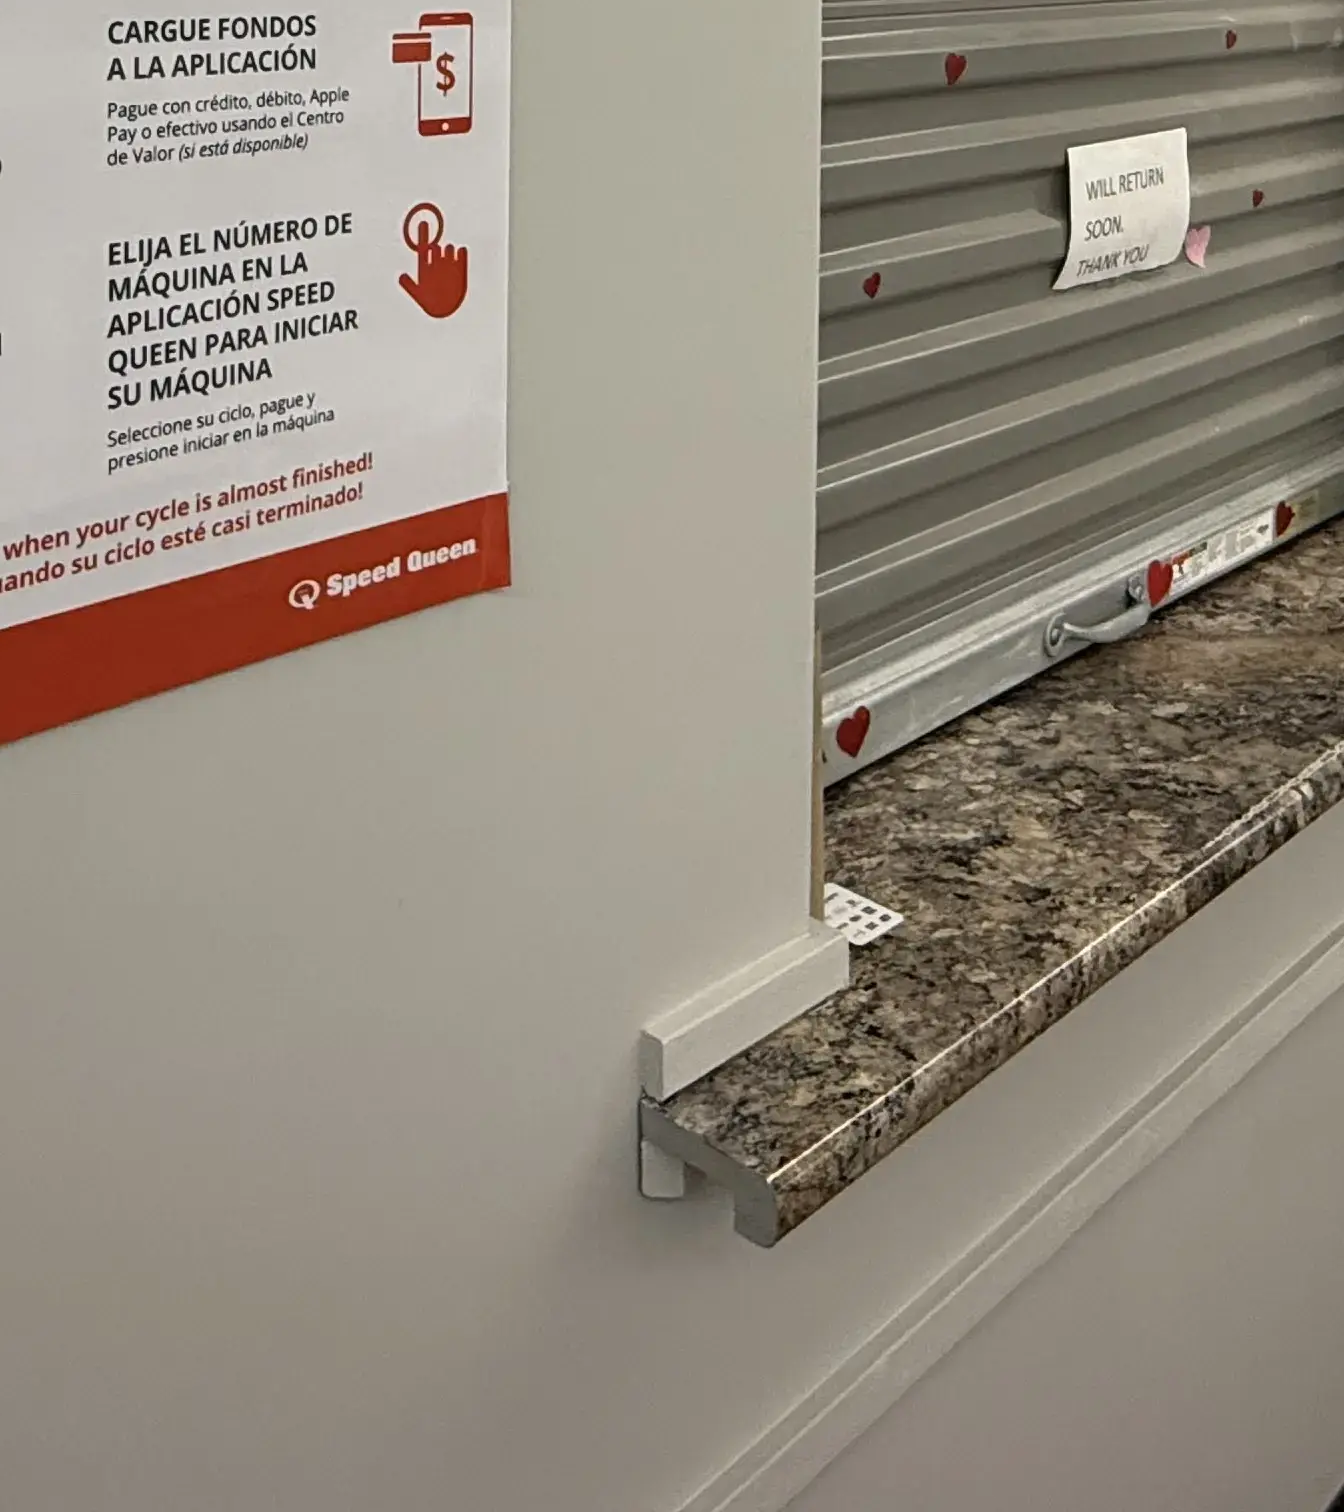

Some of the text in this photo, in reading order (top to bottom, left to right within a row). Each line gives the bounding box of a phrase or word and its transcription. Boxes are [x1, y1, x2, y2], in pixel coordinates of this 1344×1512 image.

[108, 15, 316, 45] CARGUE FONDOS
[107, 44, 316, 81] A LA APLICACIÓN
[1086, 167, 1165, 200] WILL RETURN
[1077, 244, 1149, 277] THANK YOU
[2, 528, 70, 565] when
[77, 512, 130, 550] your
[135, 497, 189, 533] cycle
[196, 489, 212, 514] is
[218, 476, 286, 510] almost
[292, 452, 374, 493] finished!
[72, 548, 97, 573] su
[105, 529, 155, 567] ciclo
[161, 519, 205, 556] esté
[213, 509, 252, 539] casi
[257, 482, 364, 527] terminado!
[327, 538, 477, 598] Speed Queen
